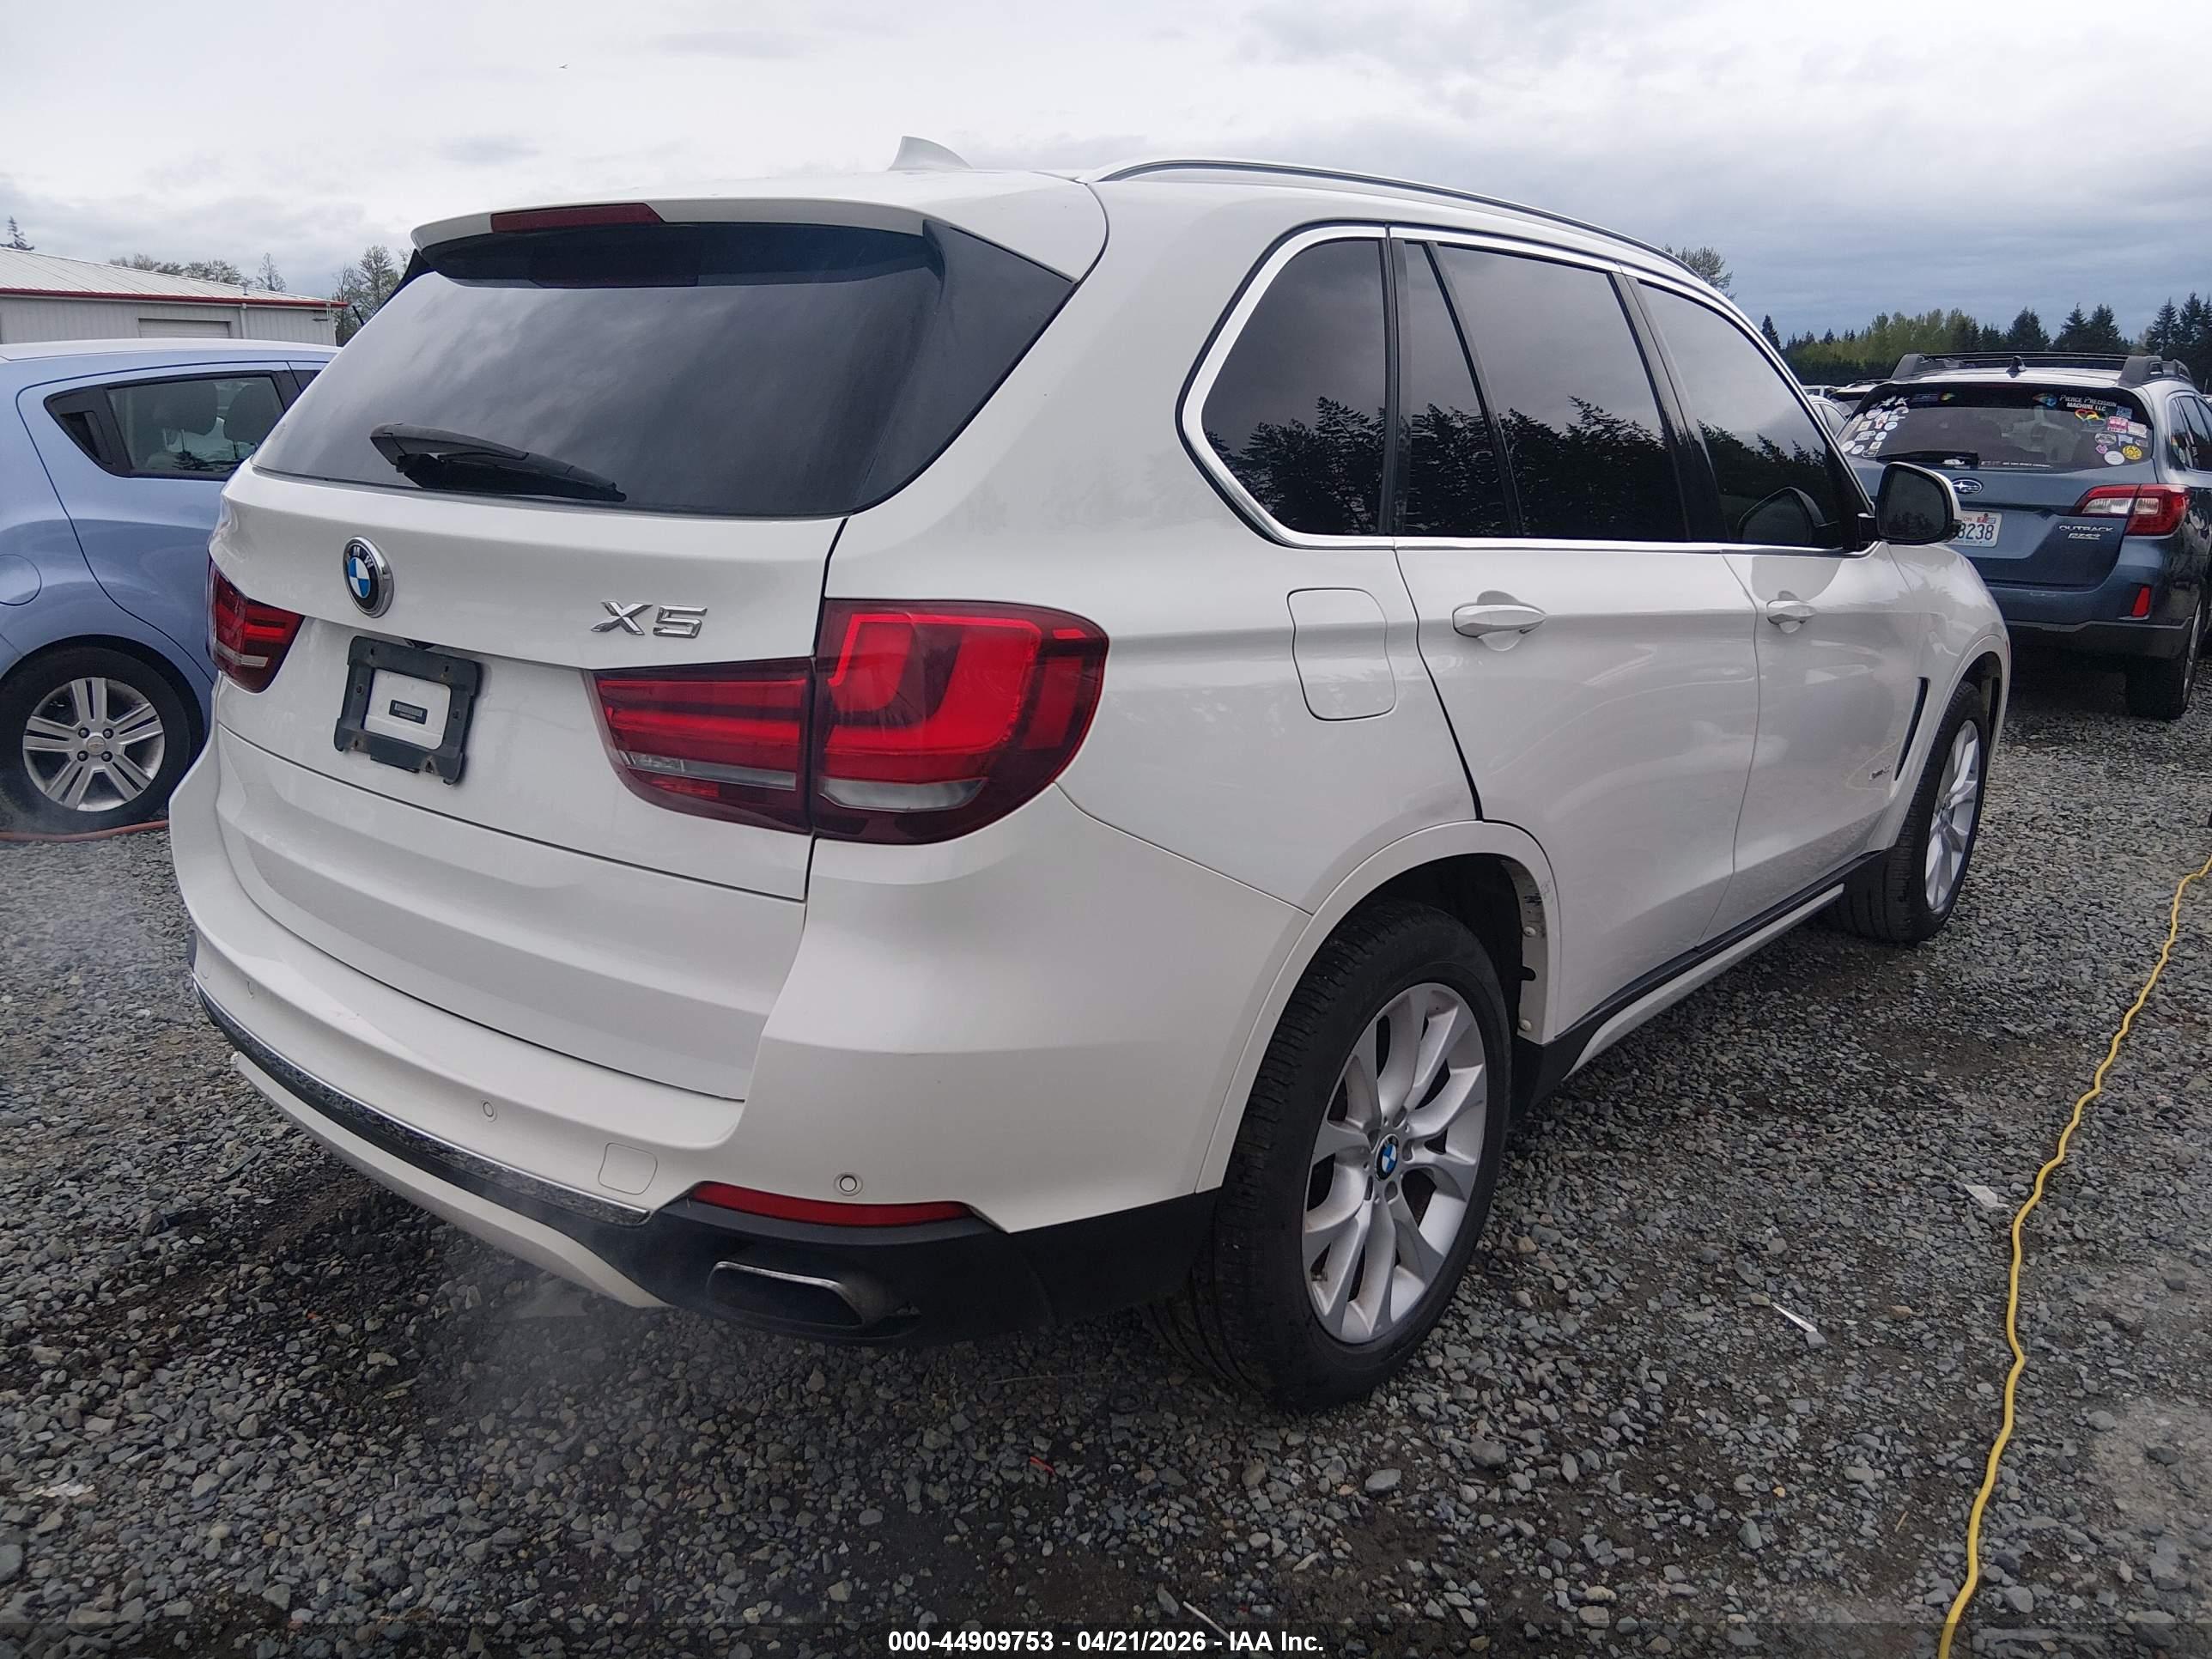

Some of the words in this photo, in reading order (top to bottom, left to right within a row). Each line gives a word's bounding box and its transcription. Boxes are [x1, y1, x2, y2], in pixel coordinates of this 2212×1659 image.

[2059, 394, 2082, 404] PIERCE
[2084, 397, 2117, 407] PRECISION
[1958, 522, 1995, 541] 8238
[591, 601, 708, 639] X5
